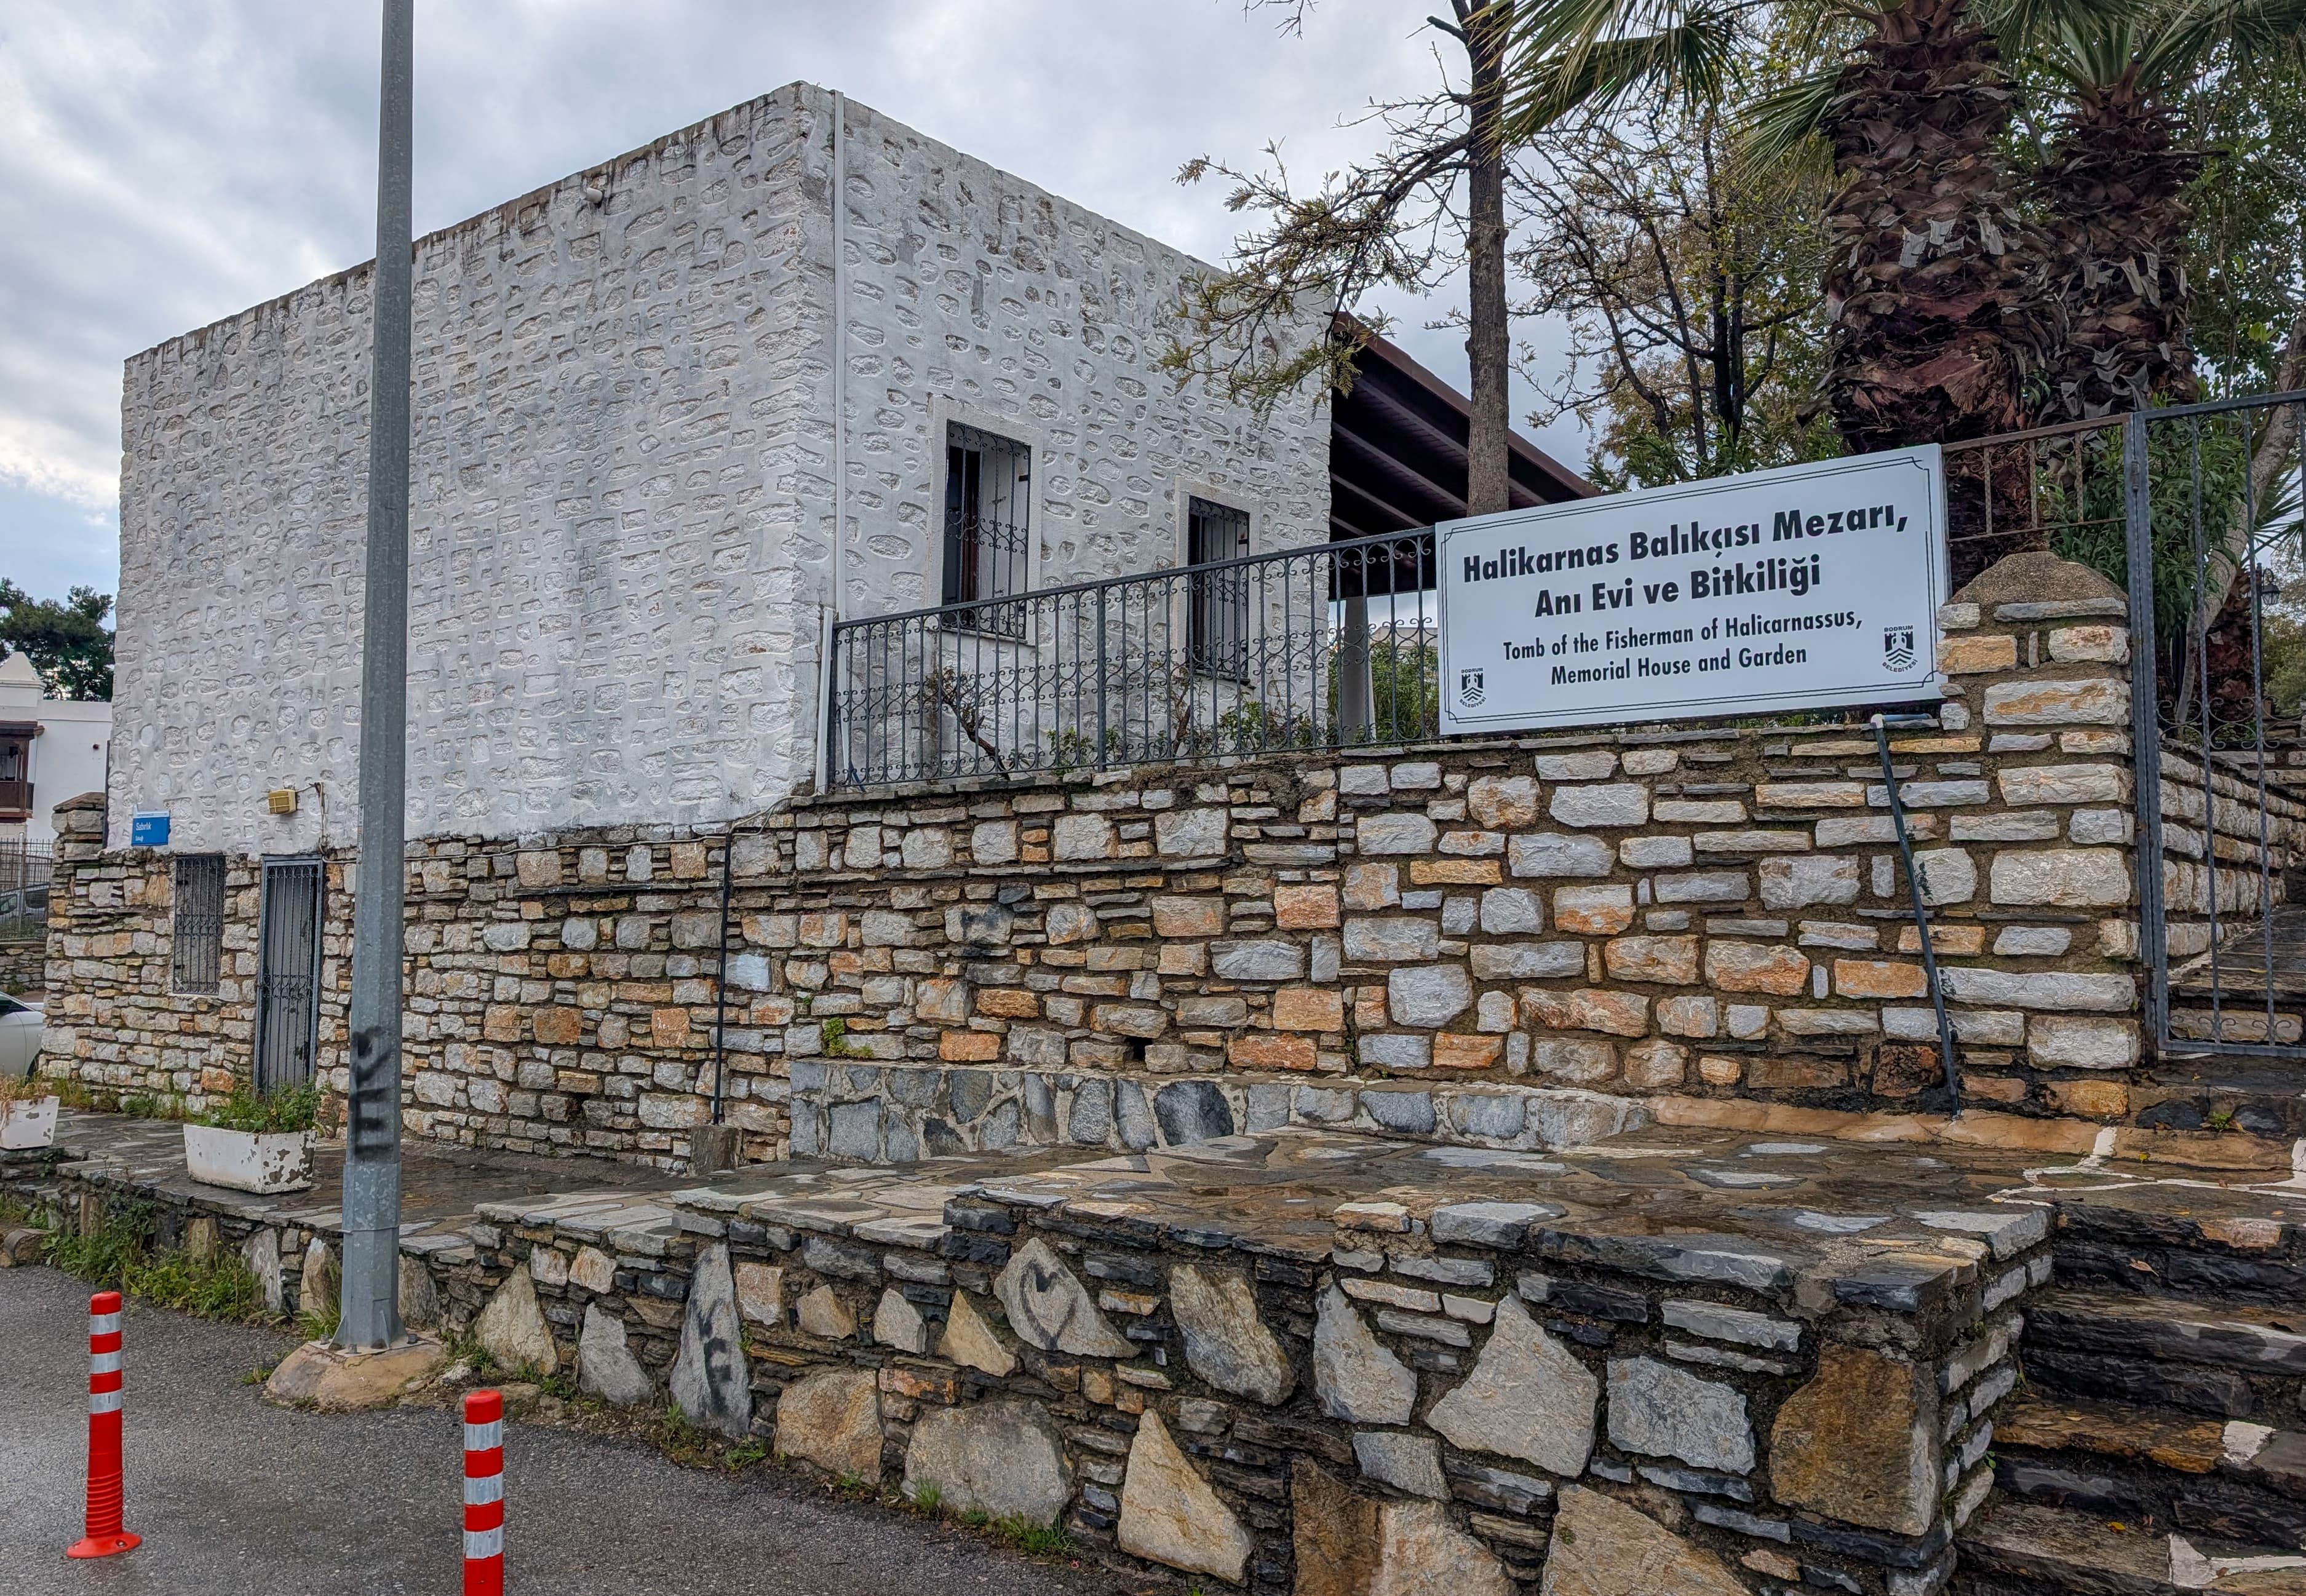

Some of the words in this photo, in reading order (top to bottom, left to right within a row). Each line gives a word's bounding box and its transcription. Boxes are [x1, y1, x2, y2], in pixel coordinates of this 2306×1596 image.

[1463, 542, 1619, 583] Halikarnas
[1630, 521, 1760, 560] Balıkçısı
[1773, 504, 1908, 542] Mezarı,
[1535, 589, 1581, 617] Anı
[1592, 578, 1632, 611] Evi
[1643, 581, 1679, 604] ve
[1690, 554, 1820, 600] Bitkiliği
[1503, 637, 1545, 660] Tomb
[1552, 633, 1567, 655] of
[1573, 632, 1599, 653] the
[1606, 627, 1693, 650] Fisherman
[1701, 617, 1718, 640] of
[1725, 611, 1863, 638] Halicarnassus,
[1551, 657, 1630, 685] Memorial
[1637, 657, 1691, 677] House
[1698, 648, 1731, 672] and
[1738, 643, 1807, 668] Garden
